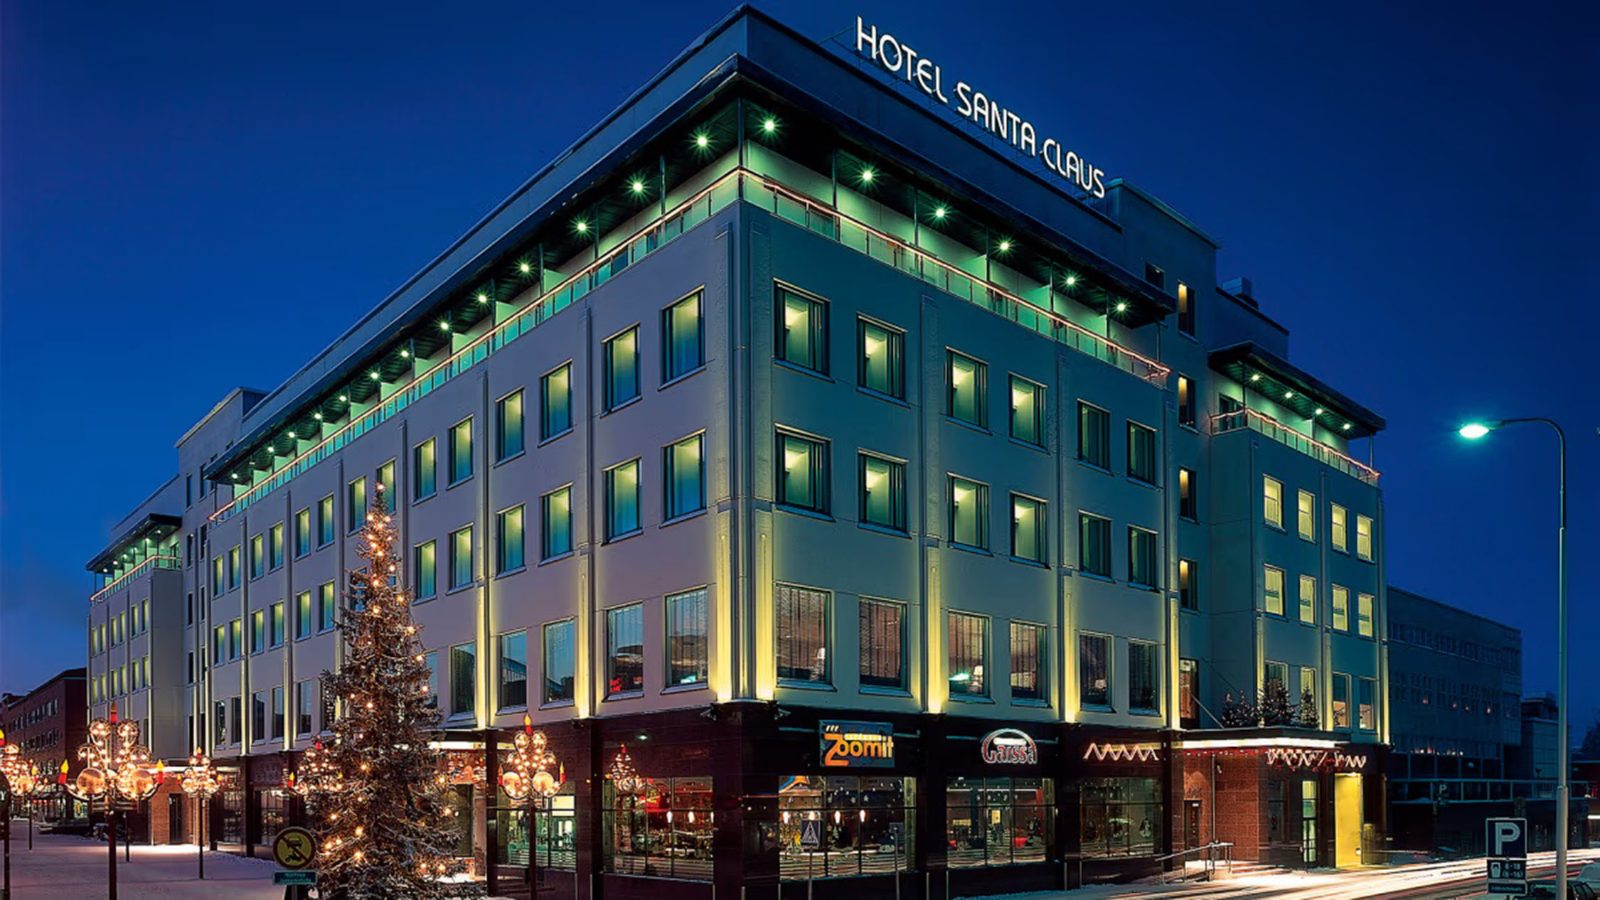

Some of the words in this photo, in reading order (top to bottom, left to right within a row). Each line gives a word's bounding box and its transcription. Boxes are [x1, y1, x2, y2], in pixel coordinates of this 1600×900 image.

[857, 16, 948, 103] HOTEL
[956, 82, 1036, 156] SANTA
[1043, 139, 1105, 199] CLAUS
[824, 733, 894, 767] Zoomit
[1495, 822, 1520, 855] P
